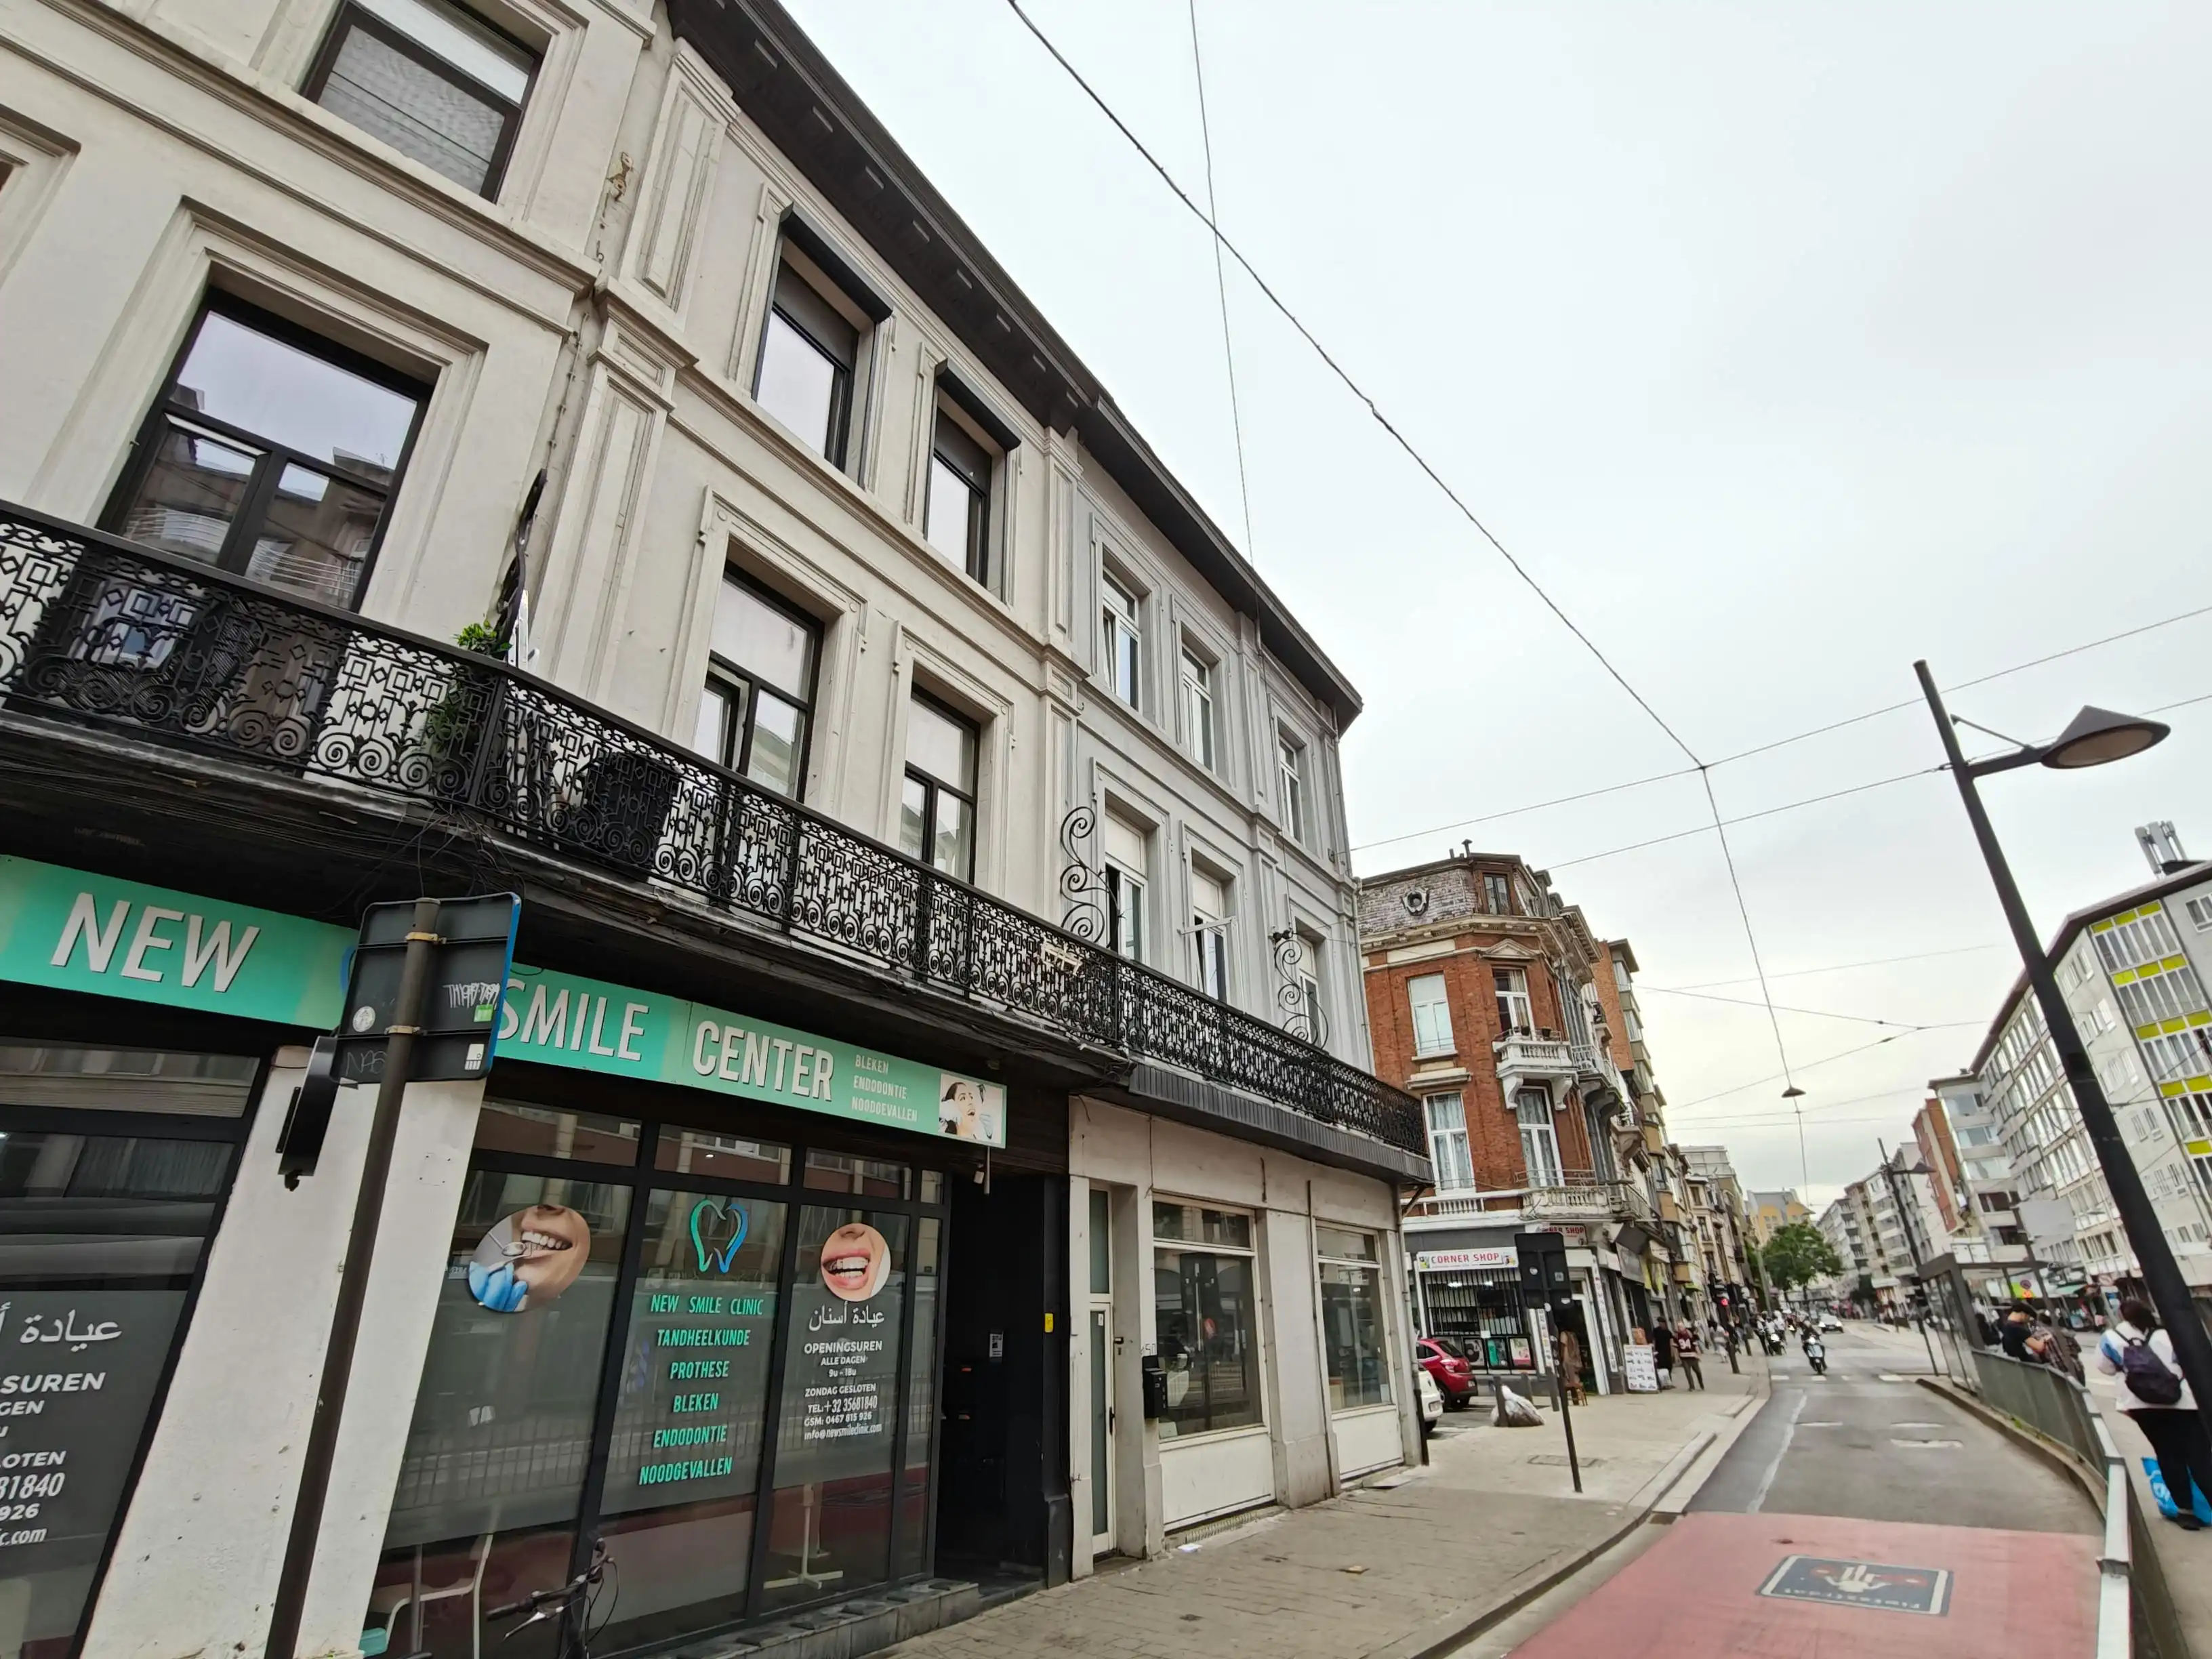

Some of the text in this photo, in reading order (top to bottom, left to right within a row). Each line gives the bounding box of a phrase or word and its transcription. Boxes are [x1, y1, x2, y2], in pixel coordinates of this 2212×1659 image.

[51, 892, 834, 1102] NEW SMILE CENTER
[855, 1054, 889, 1075] BLEKEN
[853, 1075, 908, 1100] ENDODONTIE
[851, 1096, 918, 1122] NOODGEVALLEN
[1431, 1252, 1500, 1264] CORNER SHOP
[651, 1294, 764, 1315] NEW SMILE CLINIC
[808, 1300, 884, 1332] عيادة أسنان
[20, 1309, 123, 1352] عيادة
[657, 1329, 751, 1347] TANDHEELKUNDE
[804, 1340, 883, 1354] OPENINGSUREN
[670, 1361, 730, 1380] PROTHESE
[821, 1355, 866, 1366] ALLE DAGEN
[0, 1372, 106, 1395] SUREN
[804, 1383, 876, 1397] ZONDAG GESLOTEN
[673, 1393, 719, 1413] BLEKEN
[804, 1416, 824, 1427] GSM:
[825, 1414, 844, 1425] 0467
[653, 1425, 727, 1448] ENDODONTIE
[0, 1450, 66, 1469] OTEN
[639, 1456, 733, 1485] NOODGEVALLEN
[0, 1503, 40, 1522] 926
